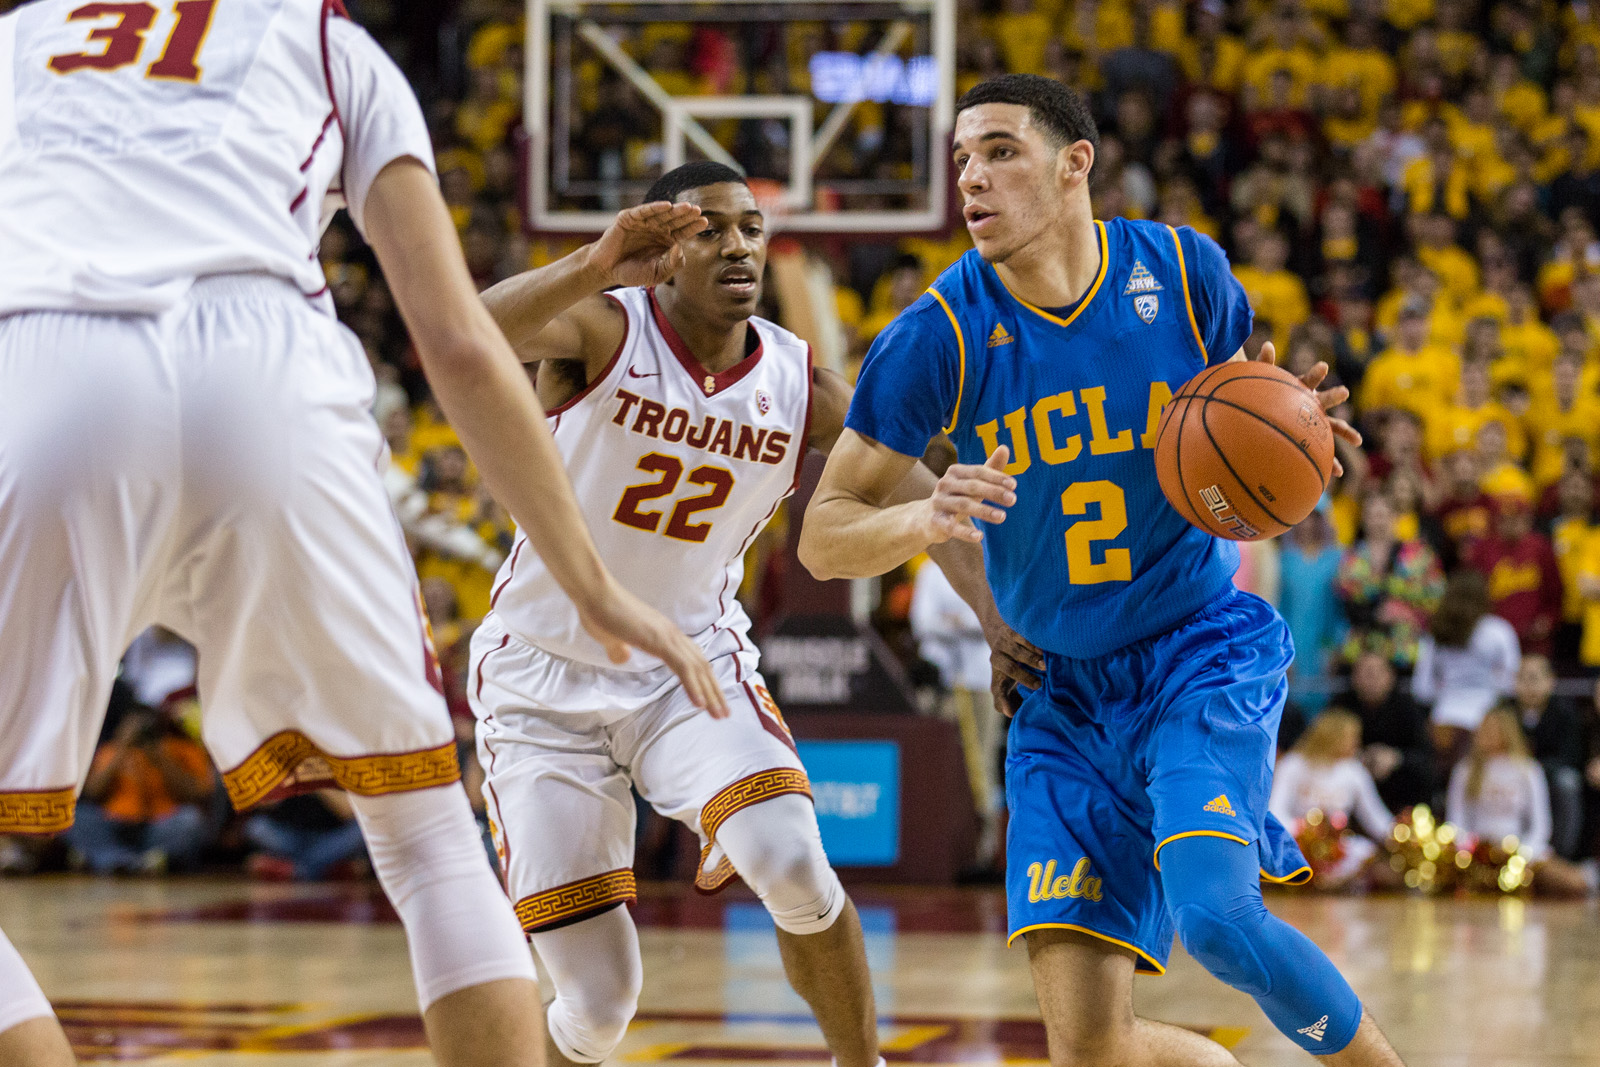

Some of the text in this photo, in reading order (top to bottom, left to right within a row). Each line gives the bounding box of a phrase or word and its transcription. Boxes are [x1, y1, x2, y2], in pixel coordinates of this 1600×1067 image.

[47, 0, 218, 84] 31
[612, 388, 791, 465] TROJANS
[612, 451, 735, 543] 22
[1061, 480, 1132, 584] 2
[1199, 485, 1260, 538] ELITE
[1203, 804, 1236, 817] adidas
[1027, 857, 1103, 903] Ucla
